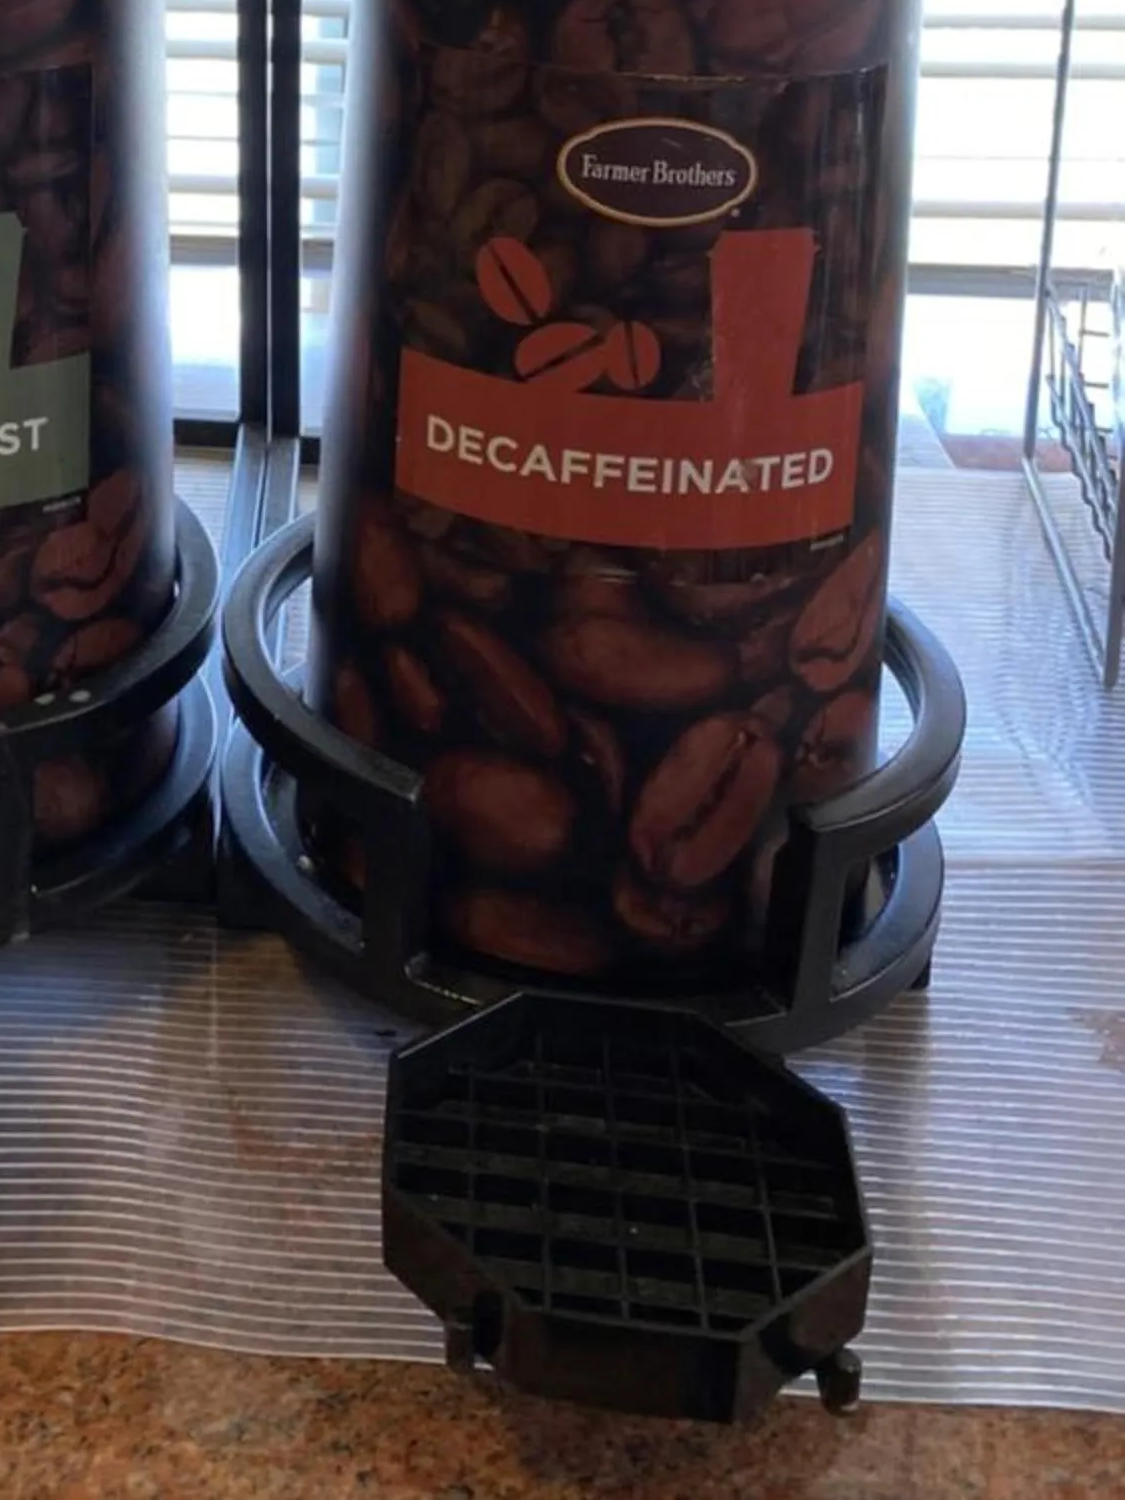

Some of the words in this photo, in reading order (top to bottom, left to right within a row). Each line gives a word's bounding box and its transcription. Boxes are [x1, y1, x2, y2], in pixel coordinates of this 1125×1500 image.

[582, 153, 650, 184] Farmer
[652, 160, 736, 187] Brothers
[426, 415, 833, 495] DECAFFEINATED
